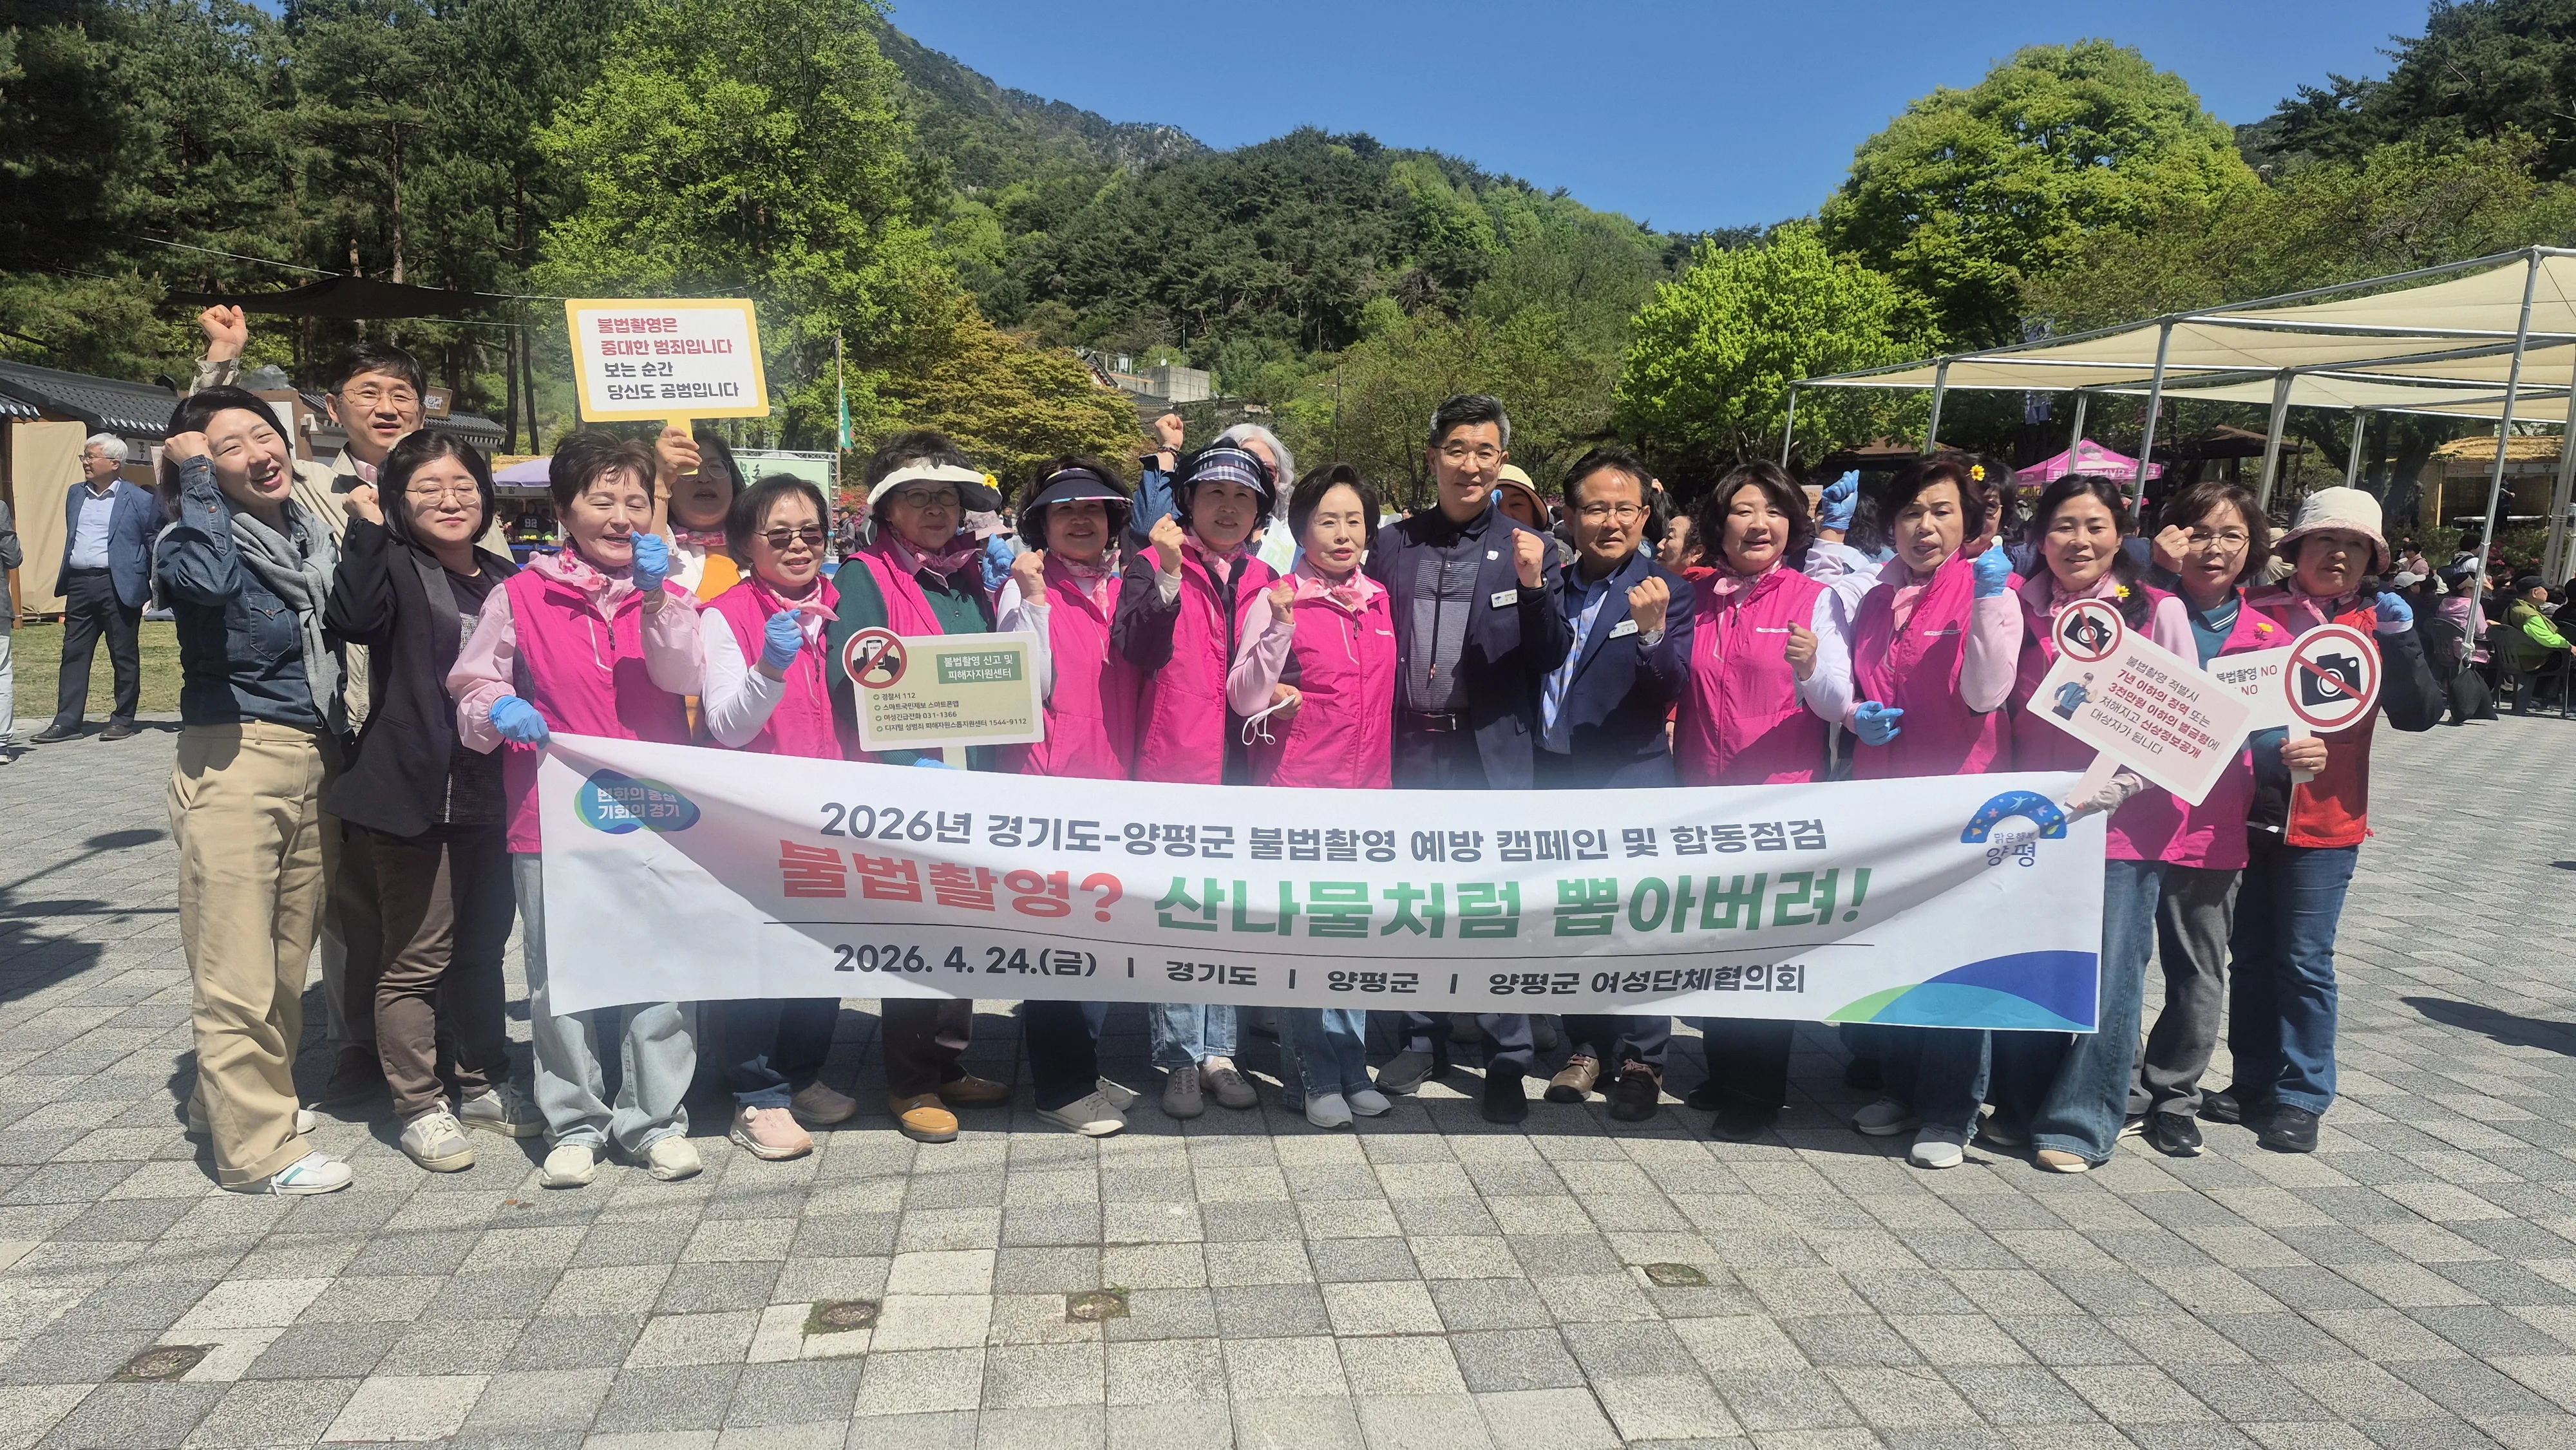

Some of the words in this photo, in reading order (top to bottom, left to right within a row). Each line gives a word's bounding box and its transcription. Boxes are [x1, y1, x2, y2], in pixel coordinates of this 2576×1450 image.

[598, 317, 677, 334] 불법촬영은
[601, 339, 649, 356] 중대한
[654, 339, 733, 355] 범죄입니다
[605, 362, 636, 377] 보는
[641, 362, 673, 377] 순간
[607, 384, 656, 400] 당신도
[660, 382, 739, 399] 공범입니다
[944, 655, 980, 667] 불법촬영
[983, 655, 1001, 666] 신고
[1004, 654, 1013, 664] 및
[948, 668, 1011, 680] 피해자지원센터
[2126, 656, 2168, 684] 불법촬영
[2168, 679, 2200, 702] 적발시
[2217, 667, 2257, 684] 불법촬영
[2260, 664, 2278, 677] NO
[2117, 669, 2136, 684] 7년
[2136, 680, 2168, 703] 이하의
[2168, 697, 2190, 715] 징역
[2189, 710, 2210, 728] 또는
[2241, 684, 2259, 696] NO
[884, 713, 921, 721] 여성긴급전화
[2108, 683, 2148, 710] 3천만원
[2147, 704, 2179, 728] 이하의
[2178, 721, 2221, 751] 벌금형에
[2090, 708, 2132, 737] 대상자가
[2132, 731, 2164, 755] 됩니다
[2099, 695, 2141, 724] 처해지고
[2140, 719, 2202, 759] 신상정보공개
[597, 787, 645, 803] 변화의
[649, 789, 677, 803] 중심
[598, 804, 646, 820] 기회의
[649, 804, 680, 818] 경기
[820, 803, 971, 844] 2026년
[988, 815, 1235, 859] 경기도-양평군
[1249, 827, 1396, 862] 불법촬영
[1411, 829, 1484, 862] 예방
[1497, 828, 1607, 862] 캠페인
[1622, 827, 1658, 857] 및
[1671, 819, 1827, 856] 합동점검
[1986, 841, 2036, 867] 양평
[779, 839, 1122, 923] 불법촬영?
[1155, 876, 1520, 939] 산나물처럼
[1553, 868, 1872, 937] 뽑아버려!
[834, 945, 933, 974] 2026.
[944, 946, 973, 974] 4.
[986, 947, 1097, 977] 24.(금)
[1166, 961, 1257, 986] 경기도
[1327, 972, 1419, 993] 양평군
[1489, 973, 1580, 995] 양평군
[1592, 964, 1804, 993] 여성단체협의회
